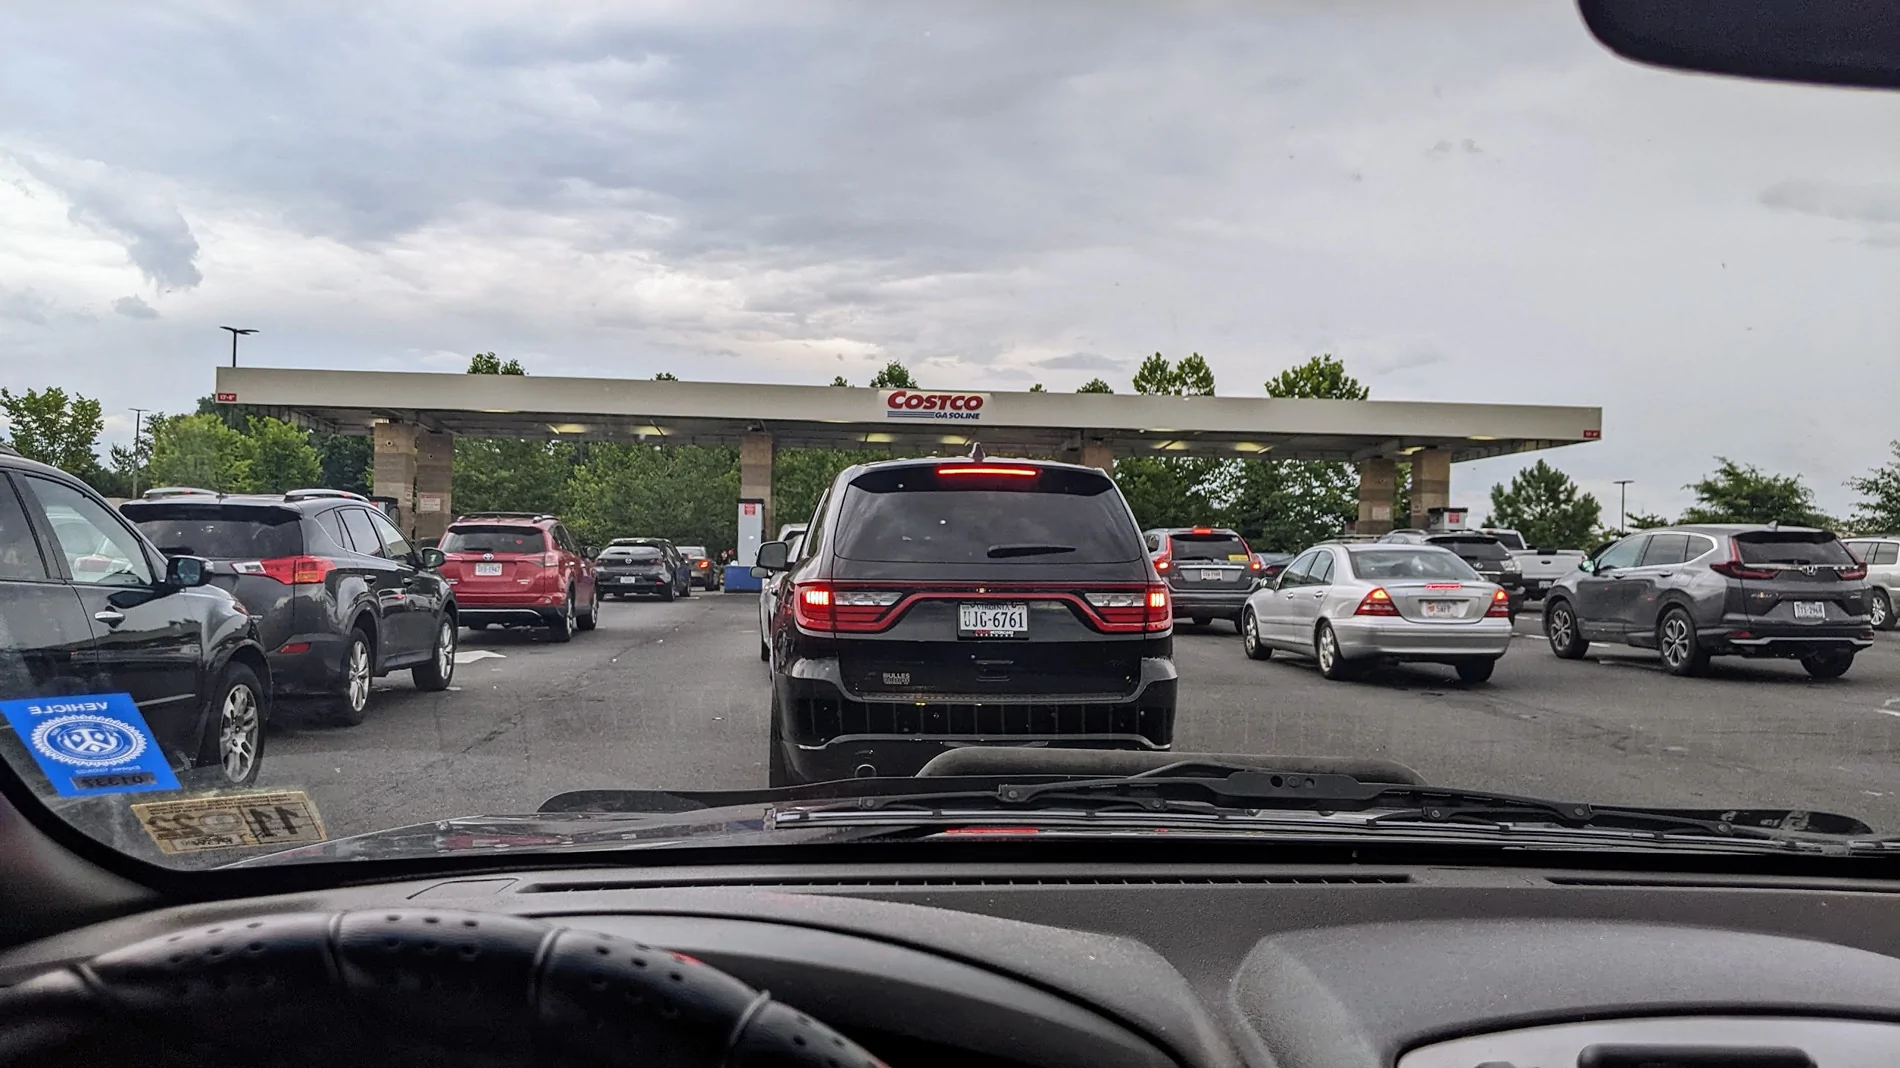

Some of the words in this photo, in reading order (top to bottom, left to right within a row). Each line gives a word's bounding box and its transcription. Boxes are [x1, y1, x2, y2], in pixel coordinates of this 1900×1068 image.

[888, 390, 983, 411] COSTCO
[935, 412, 980, 420] GASOLINE
[963, 611, 1024, 628] UJG-6761
